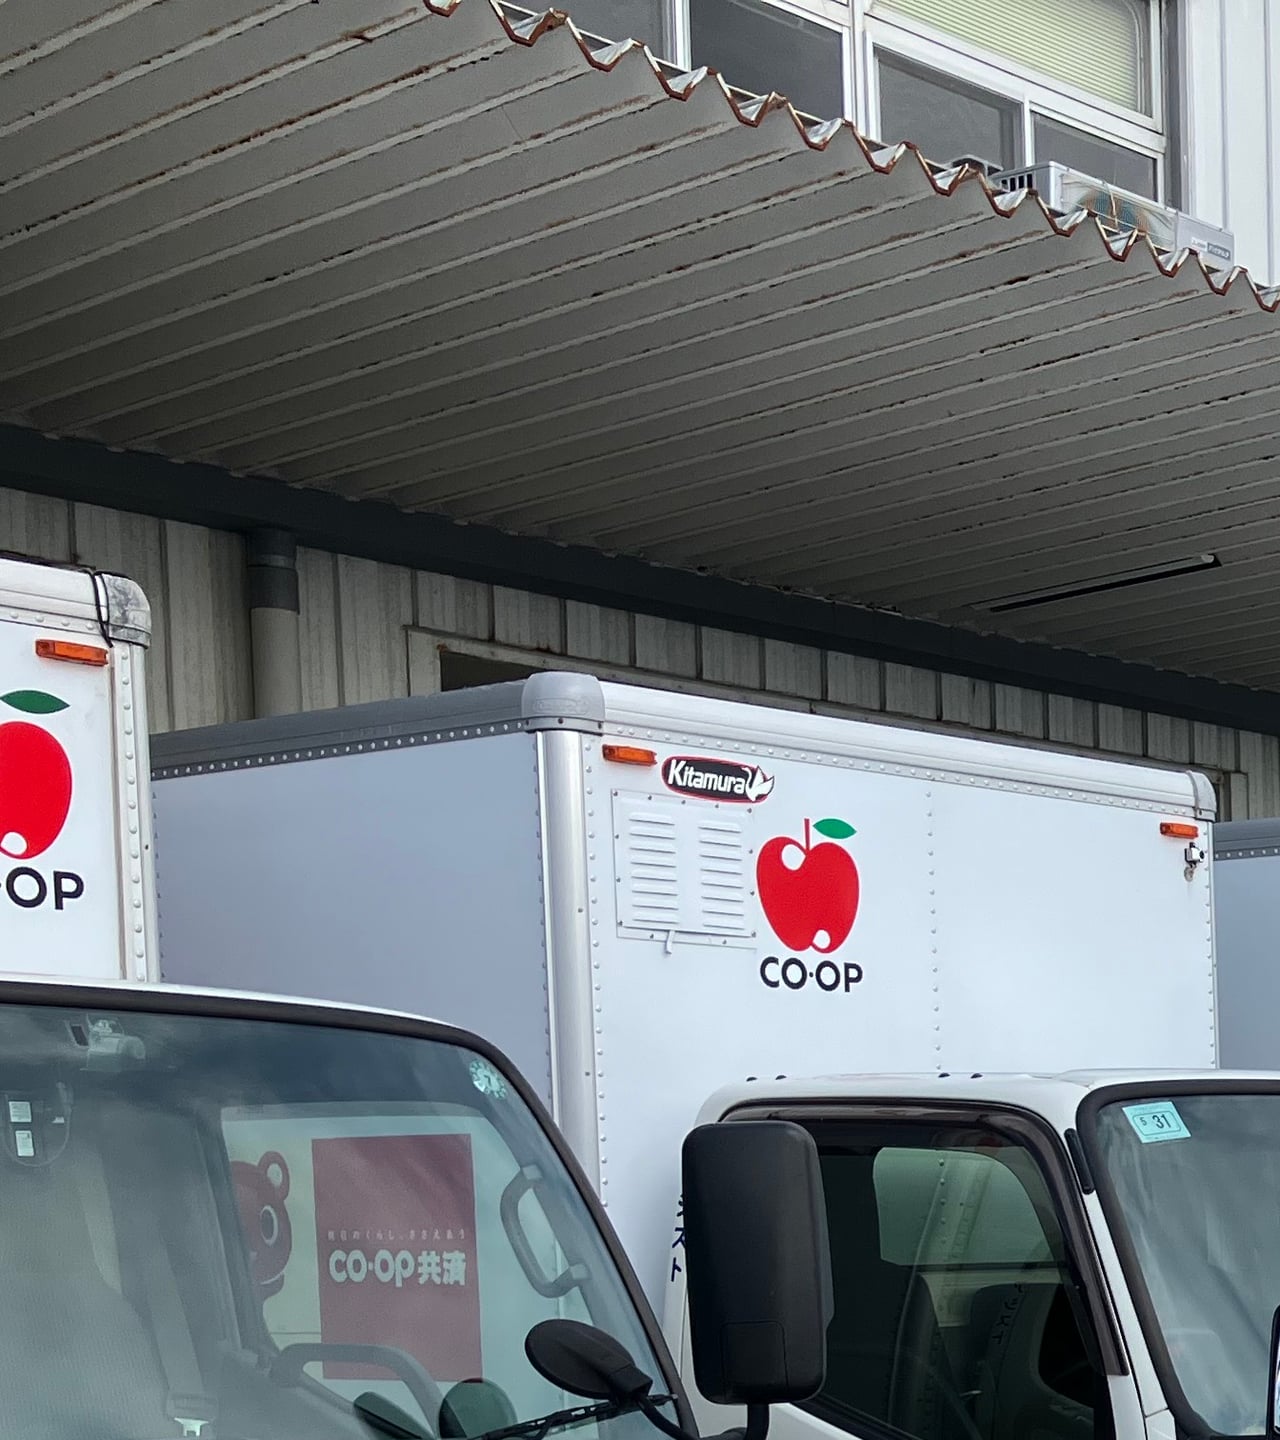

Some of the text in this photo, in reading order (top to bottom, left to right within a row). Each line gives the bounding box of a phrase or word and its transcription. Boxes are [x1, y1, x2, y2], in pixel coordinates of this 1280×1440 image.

[668, 758, 745, 796] Kitamura
[0, 866, 84, 910] OP
[1152, 1113, 1171, 1129] 31
